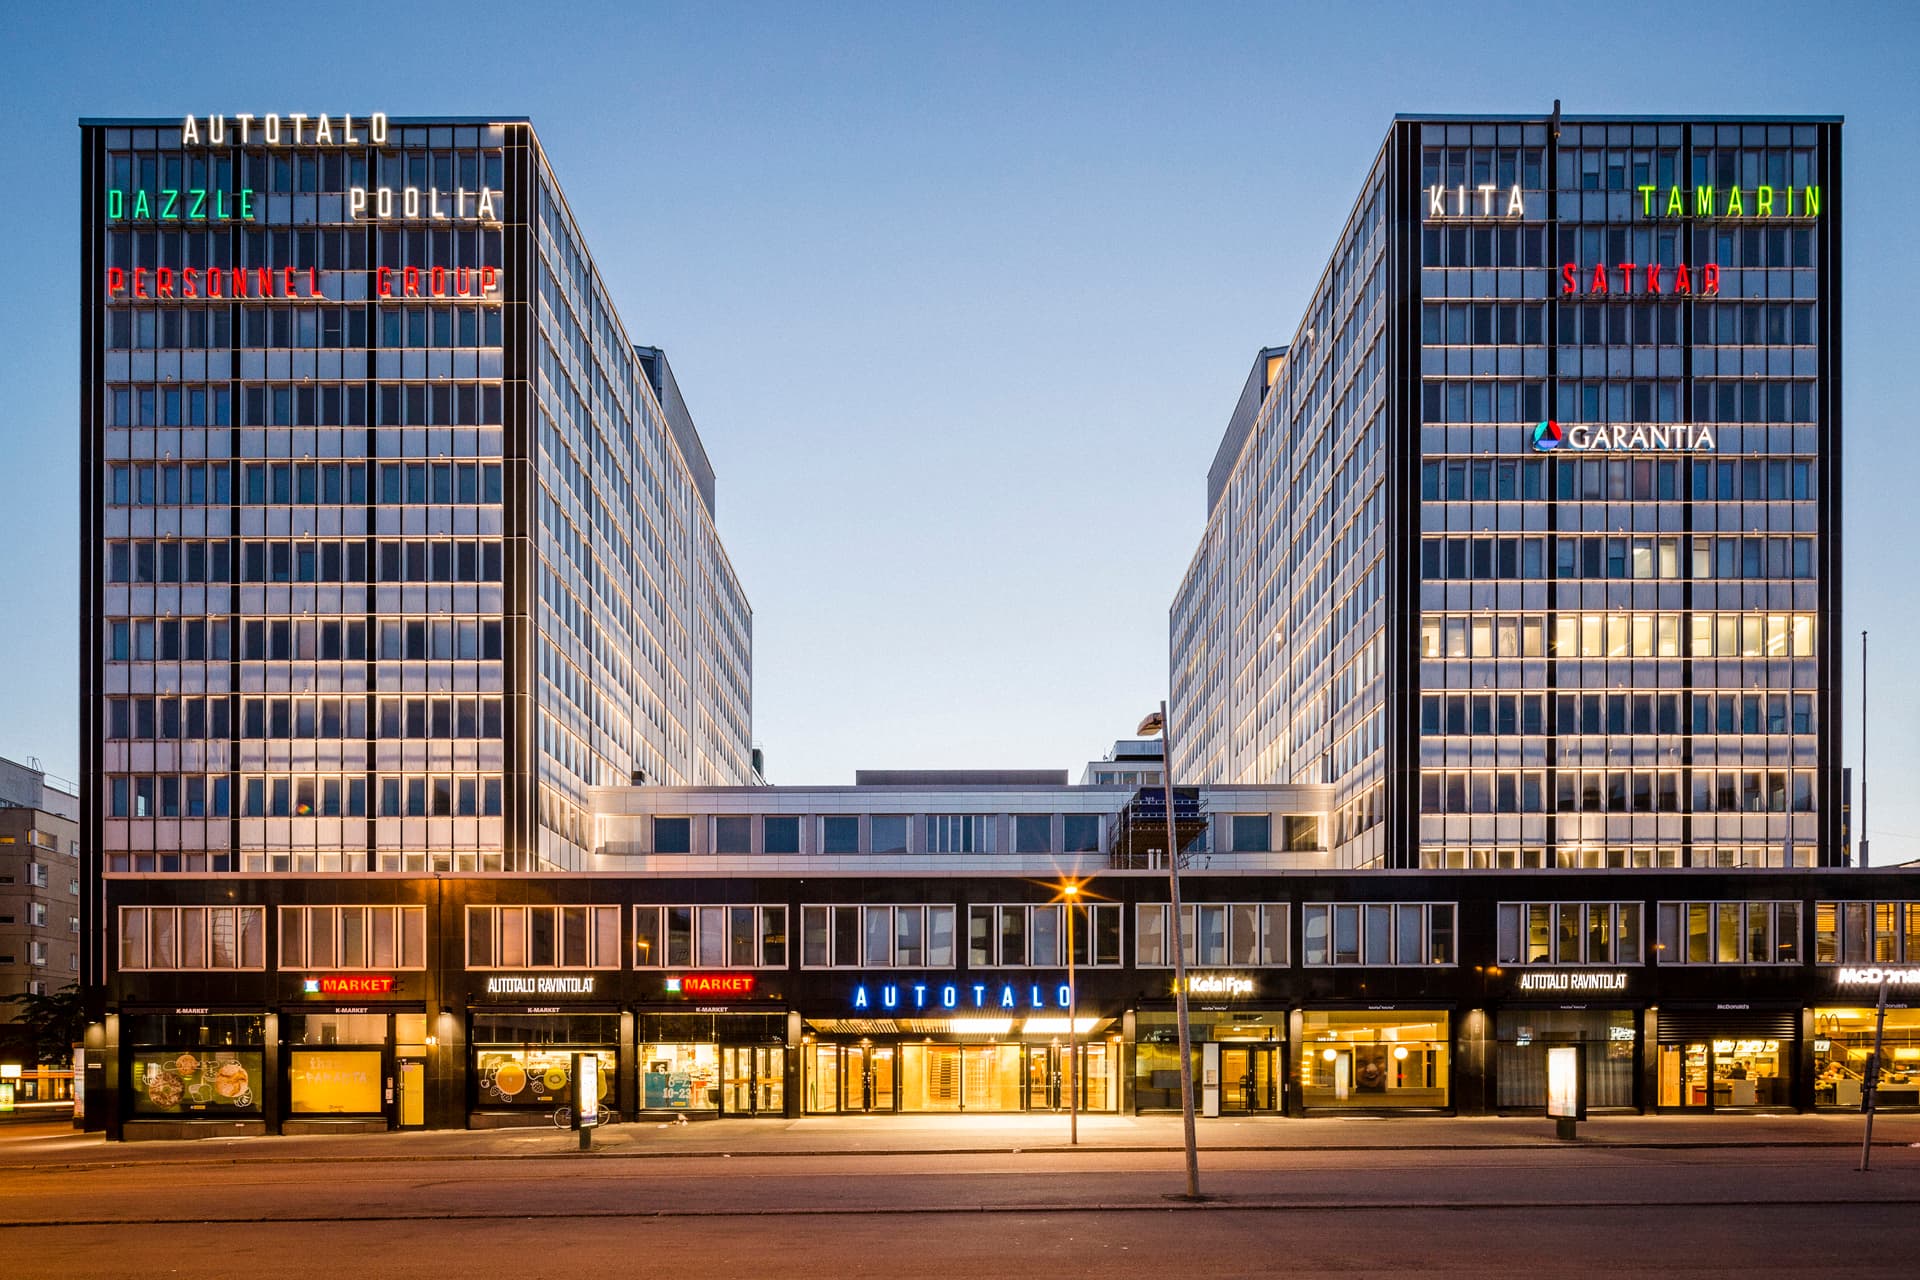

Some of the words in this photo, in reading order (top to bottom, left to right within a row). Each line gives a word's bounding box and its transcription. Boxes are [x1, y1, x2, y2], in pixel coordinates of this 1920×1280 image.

[183, 112, 387, 145] AUTOTALO
[109, 189, 256, 219] DAZZLE
[350, 187, 496, 219] POOLIA
[1429, 184, 1525, 216] KITA
[1638, 185, 1821, 216] TAMARIN
[108, 266, 322, 297] PERSONNEL
[376, 266, 497, 297] GROUP
[1563, 263, 1720, 294] SATKAR
[1568, 424, 1716, 450] GARANTIA
[323, 979, 391, 991] MARKET
[487, 977, 535, 993] AUTOTALO
[537, 977, 594, 993] RAVINTOLAT
[685, 978, 752, 990] MARKET
[855, 985, 1072, 1008] AUTOTALO
[1521, 974, 1568, 989] AUTOTALO
[1570, 974, 1627, 989] RAVINTOLAT
